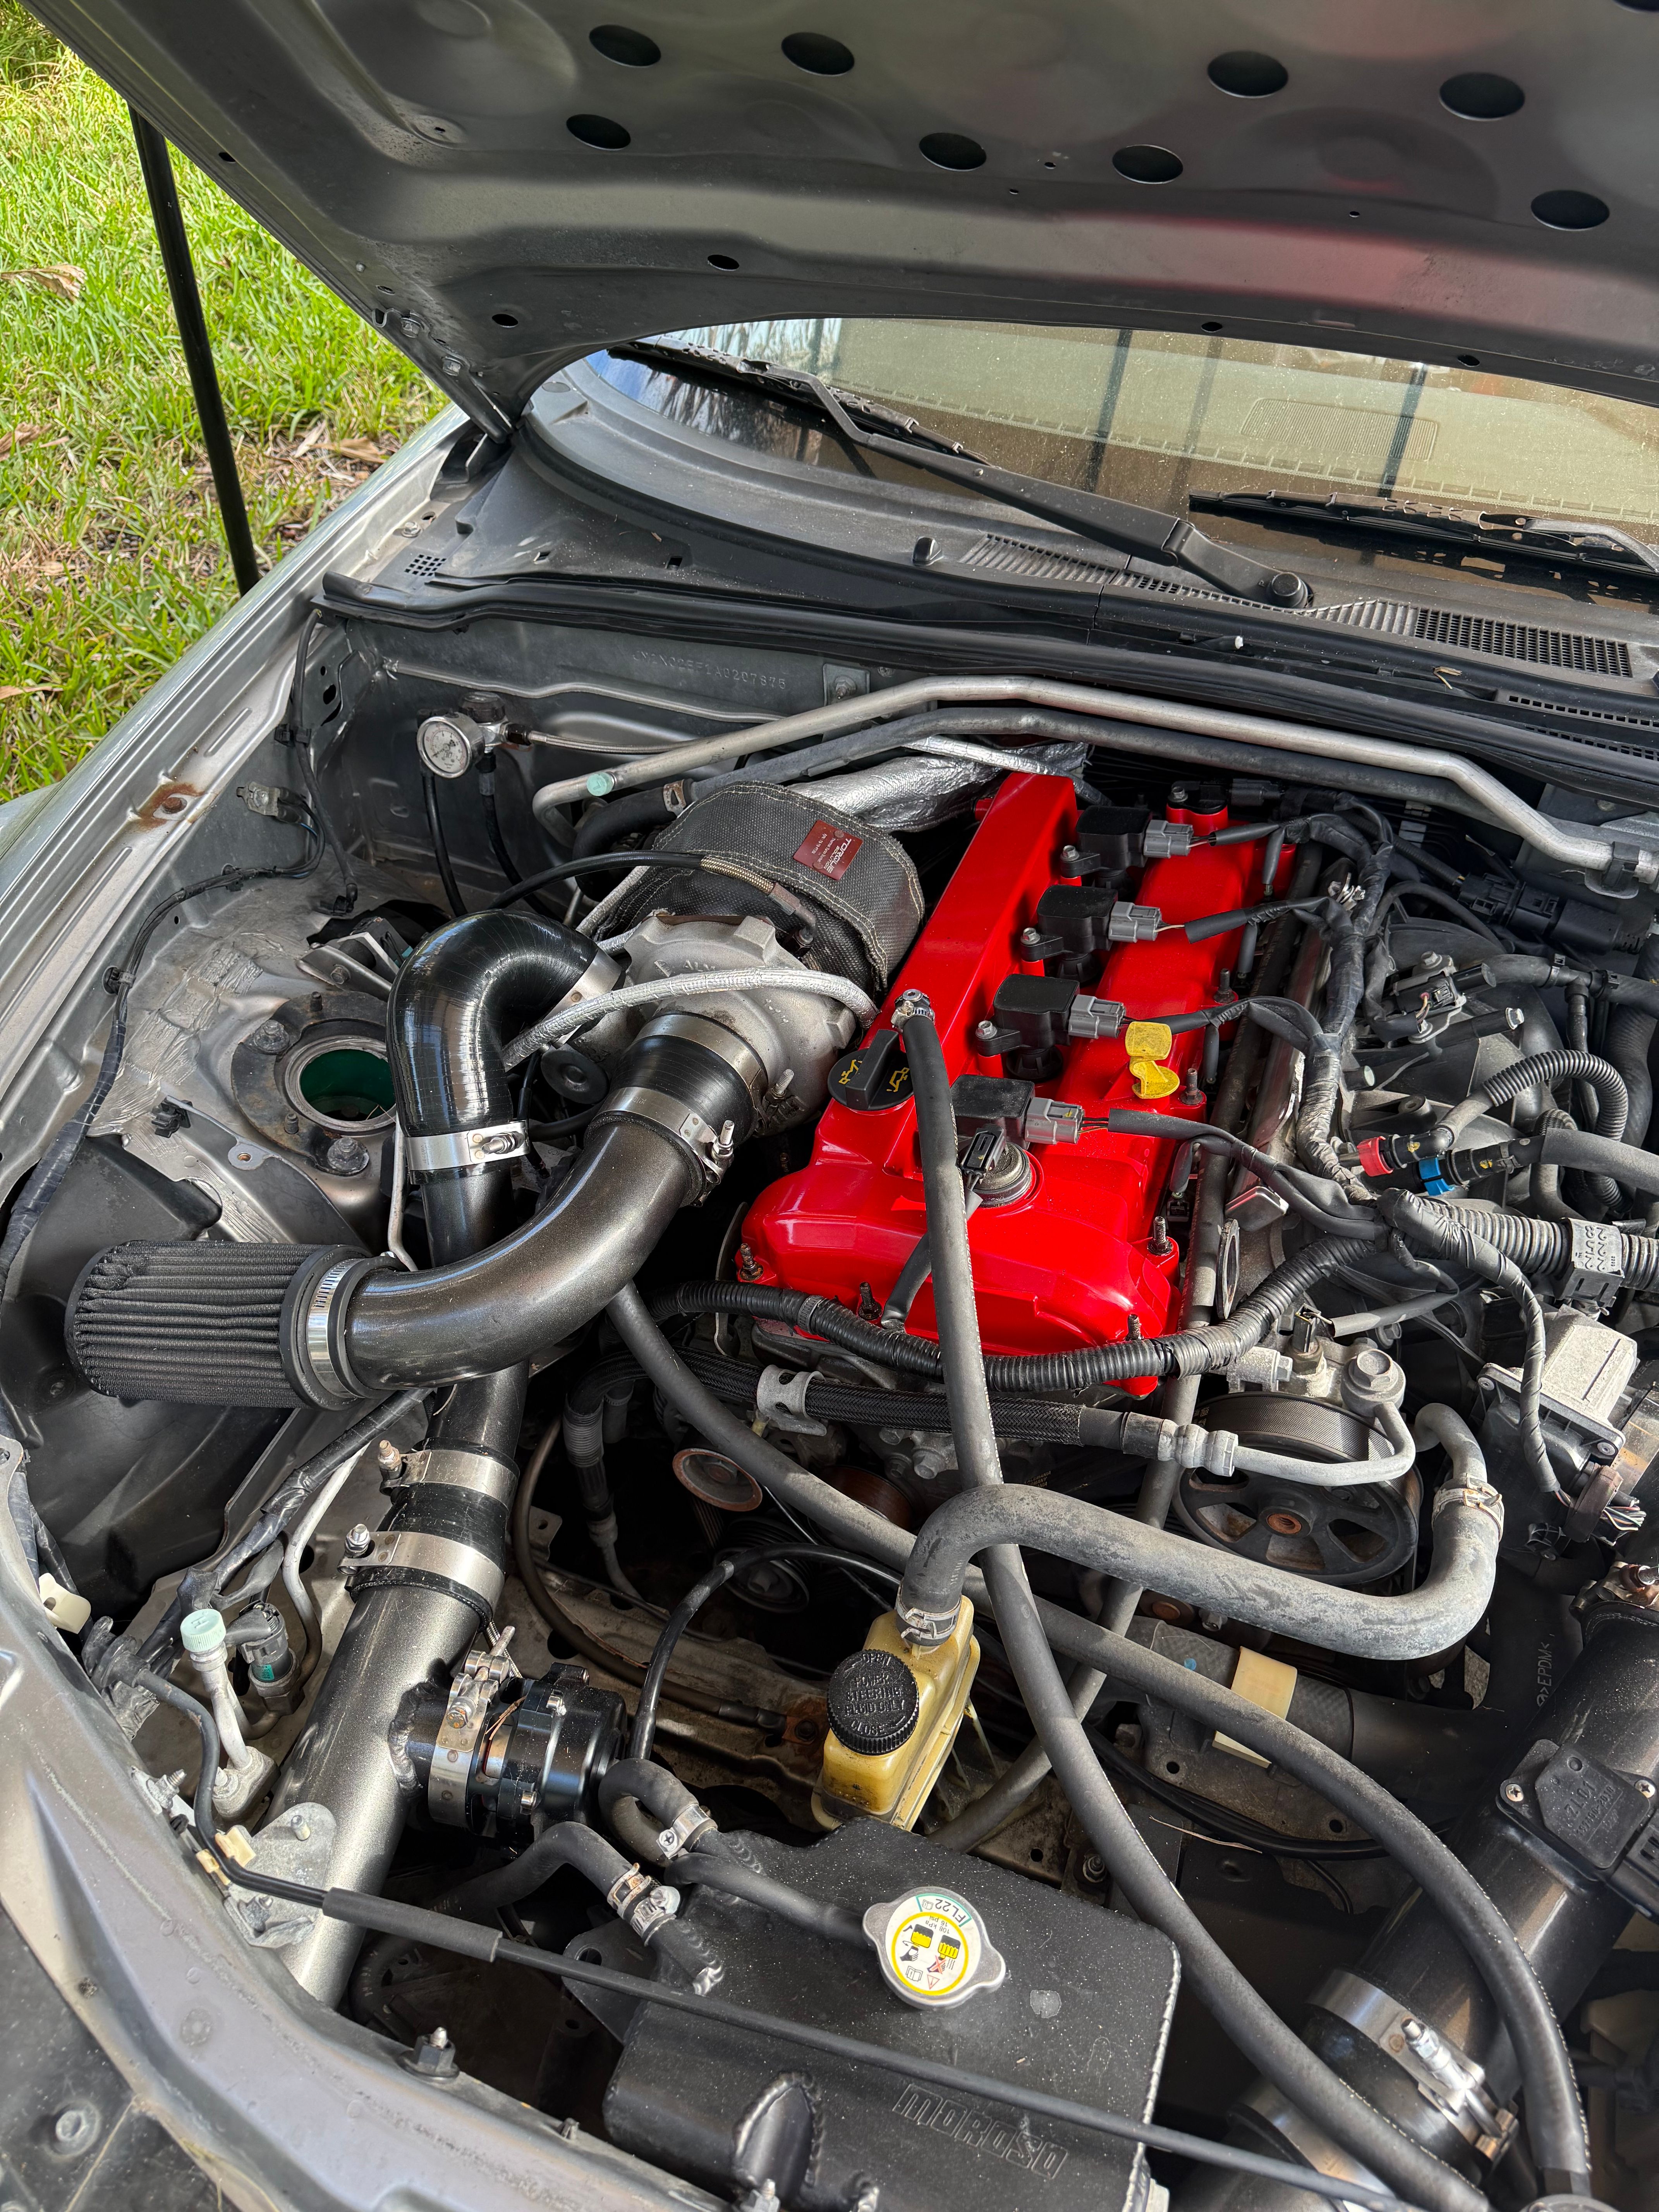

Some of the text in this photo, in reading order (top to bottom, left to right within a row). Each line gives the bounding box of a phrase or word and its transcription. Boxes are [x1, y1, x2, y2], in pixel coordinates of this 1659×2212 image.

[824, 845, 840, 869] SOLUTION
[826, 838, 852, 874] TORQUE
[862, 1654, 891, 1667] OPEN
[855, 1673, 889, 1688] POWER
[847, 1687, 902, 1702] STEERING
[845, 1700, 905, 1716] FLUID ONLY
[935, 1898, 966, 1923] FL22
[925, 1920, 937, 1929] kPa
[892, 2083, 1069, 2180] MOROSO
